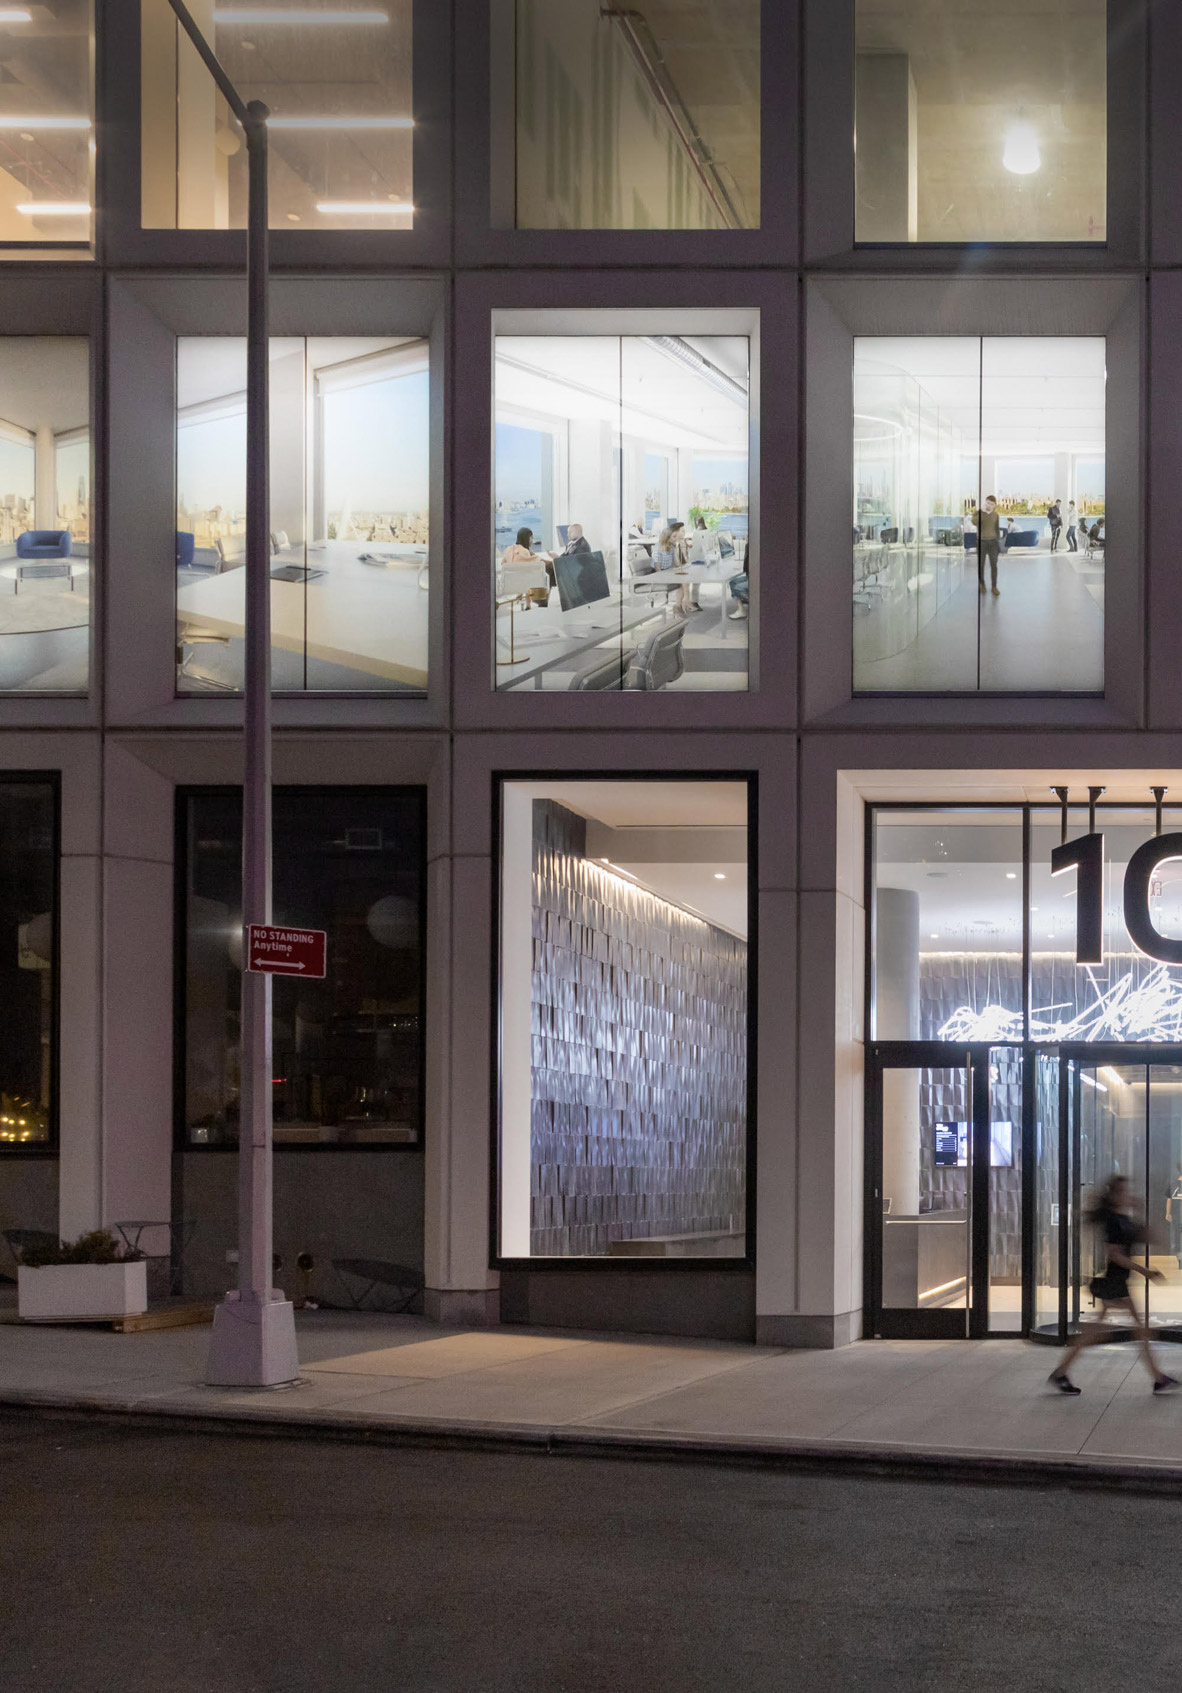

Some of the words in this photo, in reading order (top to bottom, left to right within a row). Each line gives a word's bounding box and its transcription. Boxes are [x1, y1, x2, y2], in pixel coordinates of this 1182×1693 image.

[253, 930, 267, 939] NO
[269, 931, 314, 944] STANDING
[254, 940, 293, 952] Anytime
